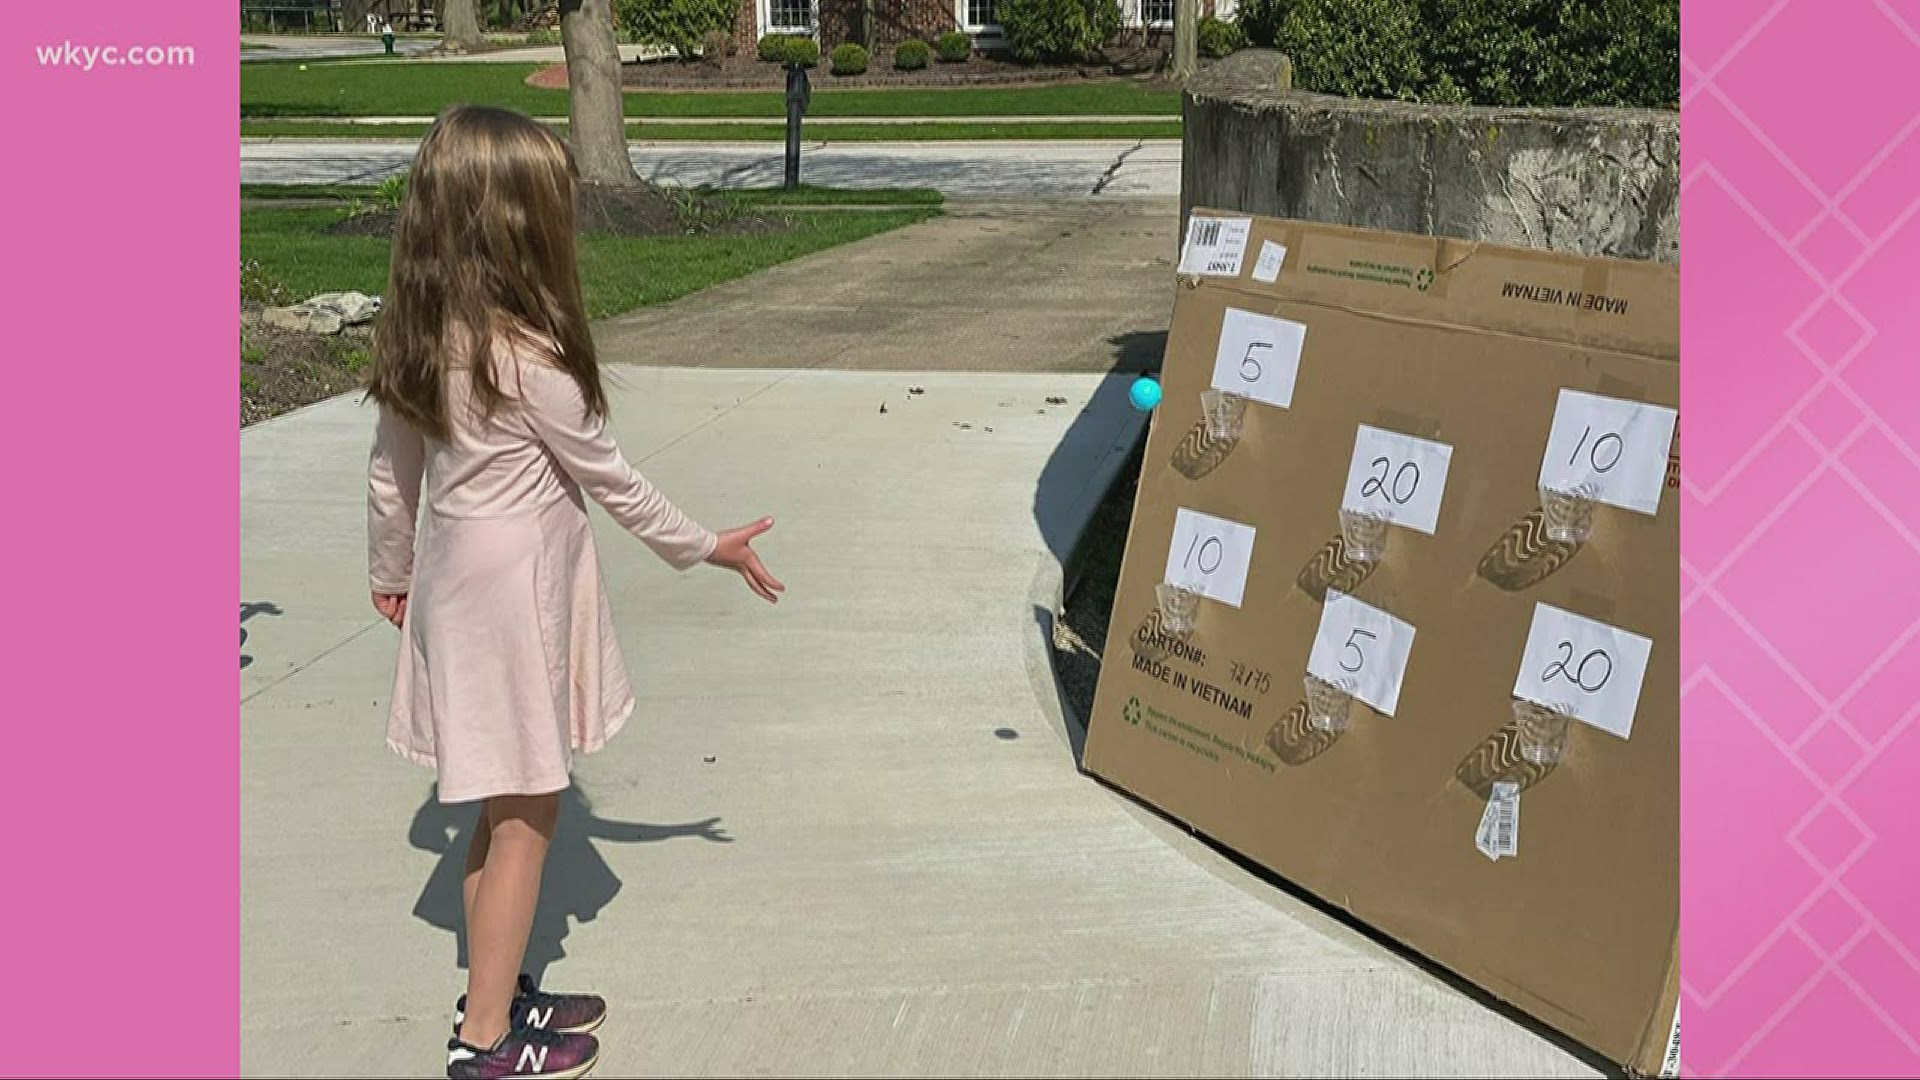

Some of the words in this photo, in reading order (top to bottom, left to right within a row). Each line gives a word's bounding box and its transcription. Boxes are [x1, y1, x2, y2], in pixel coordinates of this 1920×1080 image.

[1501, 281, 1562, 305] VIETNAM
[1566, 291, 1583, 307] IN
[1584, 294, 1629, 315] MADE
[1239, 342, 1274, 382] 5
[1569, 425, 1623, 473] 10
[1361, 456, 1420, 504] 20
[1183, 532, 1223, 574] 10
[1338, 629, 1377, 672] 5
[1541, 641, 1613, 692] 20
[1132, 653, 1172, 683] MADE
[1173, 671, 1188, 691] IN
[1191, 678, 1253, 720] VIETNAM
[526, 1007, 554, 1029] N
[514, 1044, 548, 1073] N
